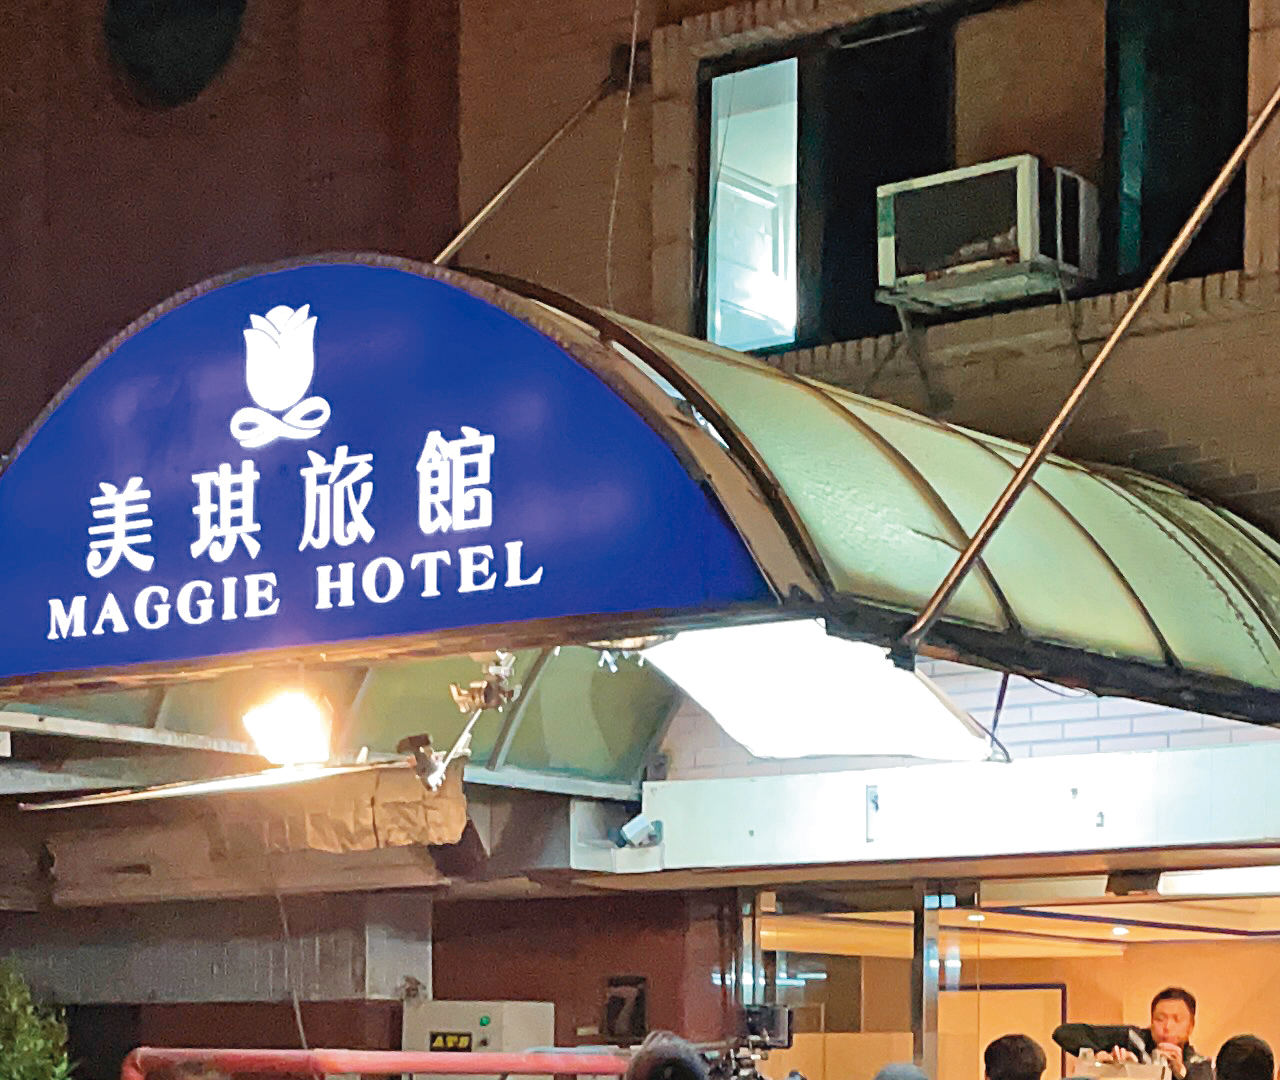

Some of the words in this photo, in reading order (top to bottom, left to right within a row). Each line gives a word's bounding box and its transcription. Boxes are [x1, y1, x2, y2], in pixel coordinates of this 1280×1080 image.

[85, 424, 496, 580] 美琪旅館
[46, 571, 282, 641] MAGGIE
[313, 540, 545, 611] HOTEL
